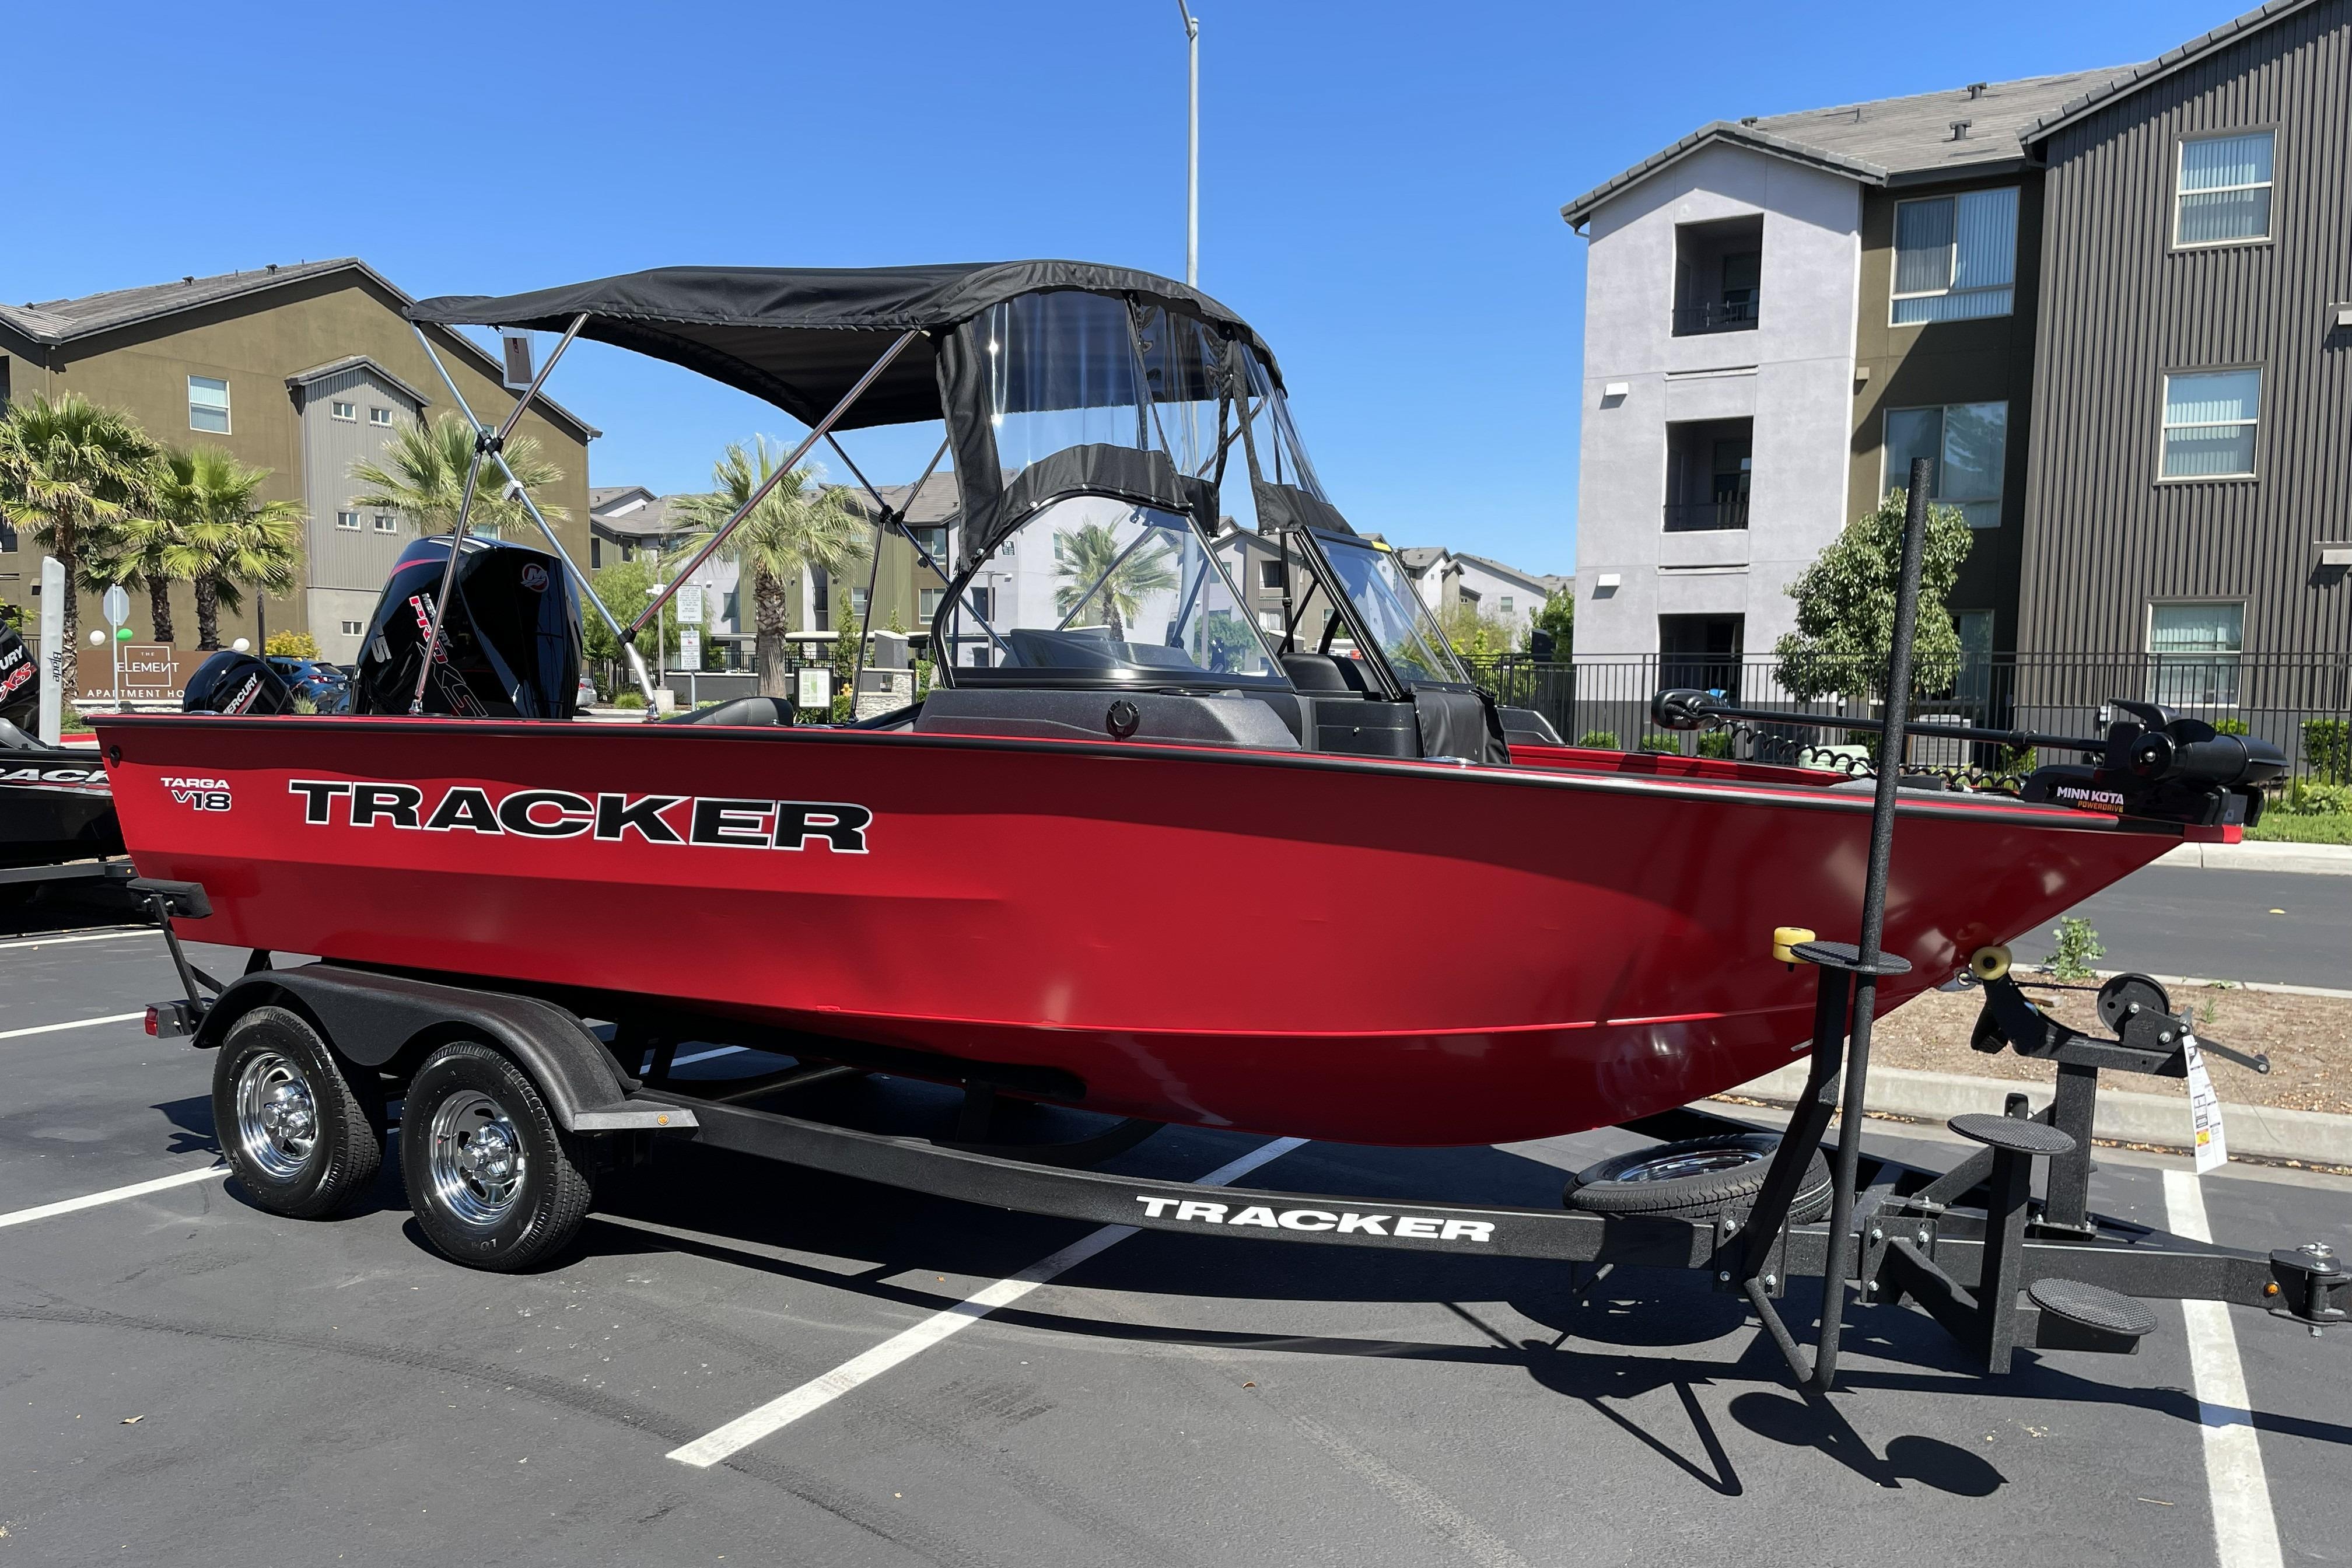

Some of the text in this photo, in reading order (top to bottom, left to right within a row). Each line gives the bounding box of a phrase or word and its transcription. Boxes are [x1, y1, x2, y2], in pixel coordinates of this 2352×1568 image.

[0, 645, 23, 670] URY
[47, 652, 62, 683] Blade
[117, 662, 180, 673] ELEMENT
[160, 778, 230, 789] TARGA
[172, 790, 232, 812] V18
[2056, 786, 2124, 805] MINN KOTA
[2077, 800, 2123, 813] POWERDRIVE
[289, 779, 873, 854] TRACKER
[1136, 1195, 1496, 1242] TRACKER
